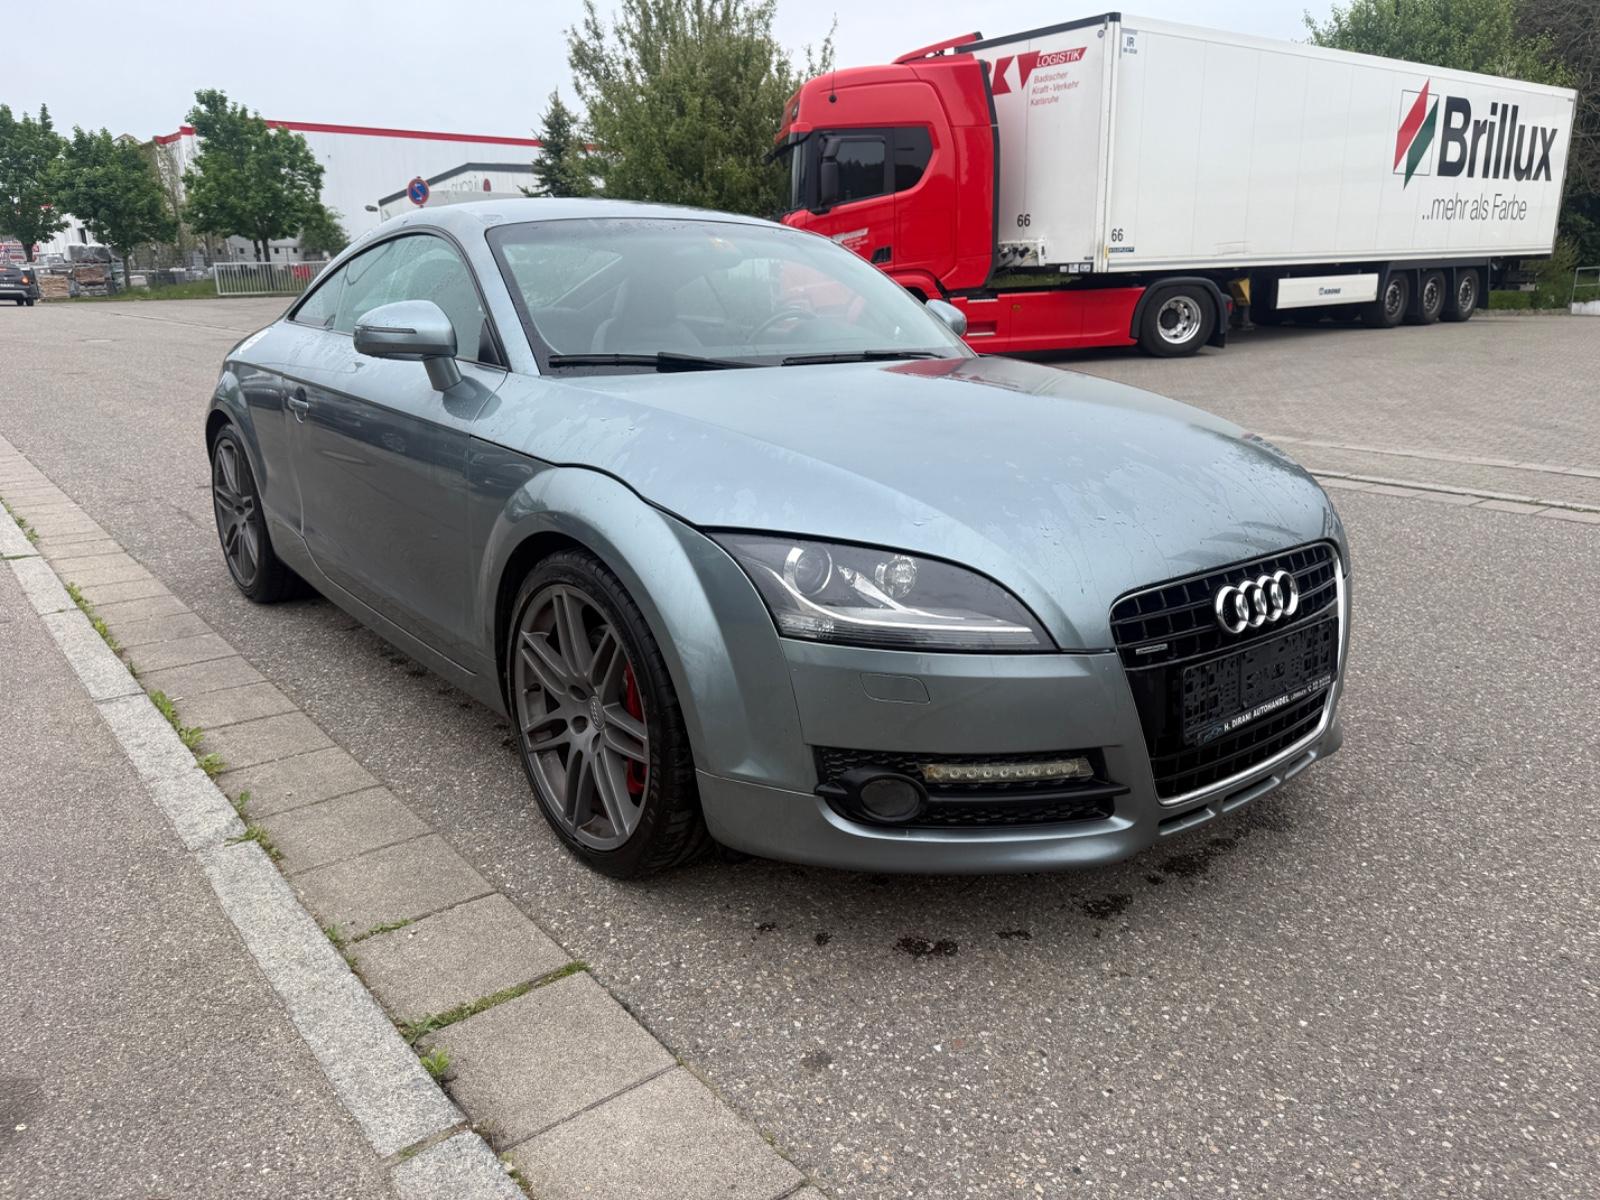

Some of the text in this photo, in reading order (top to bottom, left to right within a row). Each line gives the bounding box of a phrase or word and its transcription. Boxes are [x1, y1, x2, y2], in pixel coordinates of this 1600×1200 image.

[1036, 49, 1081, 67] LOGISTIK
[986, 50, 1041, 96] KV
[1437, 96, 1558, 182] Brillux
[1470, 193, 1489, 220] als
[1492, 193, 1527, 220] Farbe
[1017, 214, 1031, 227] 66
[1111, 228, 1123, 242] 66
